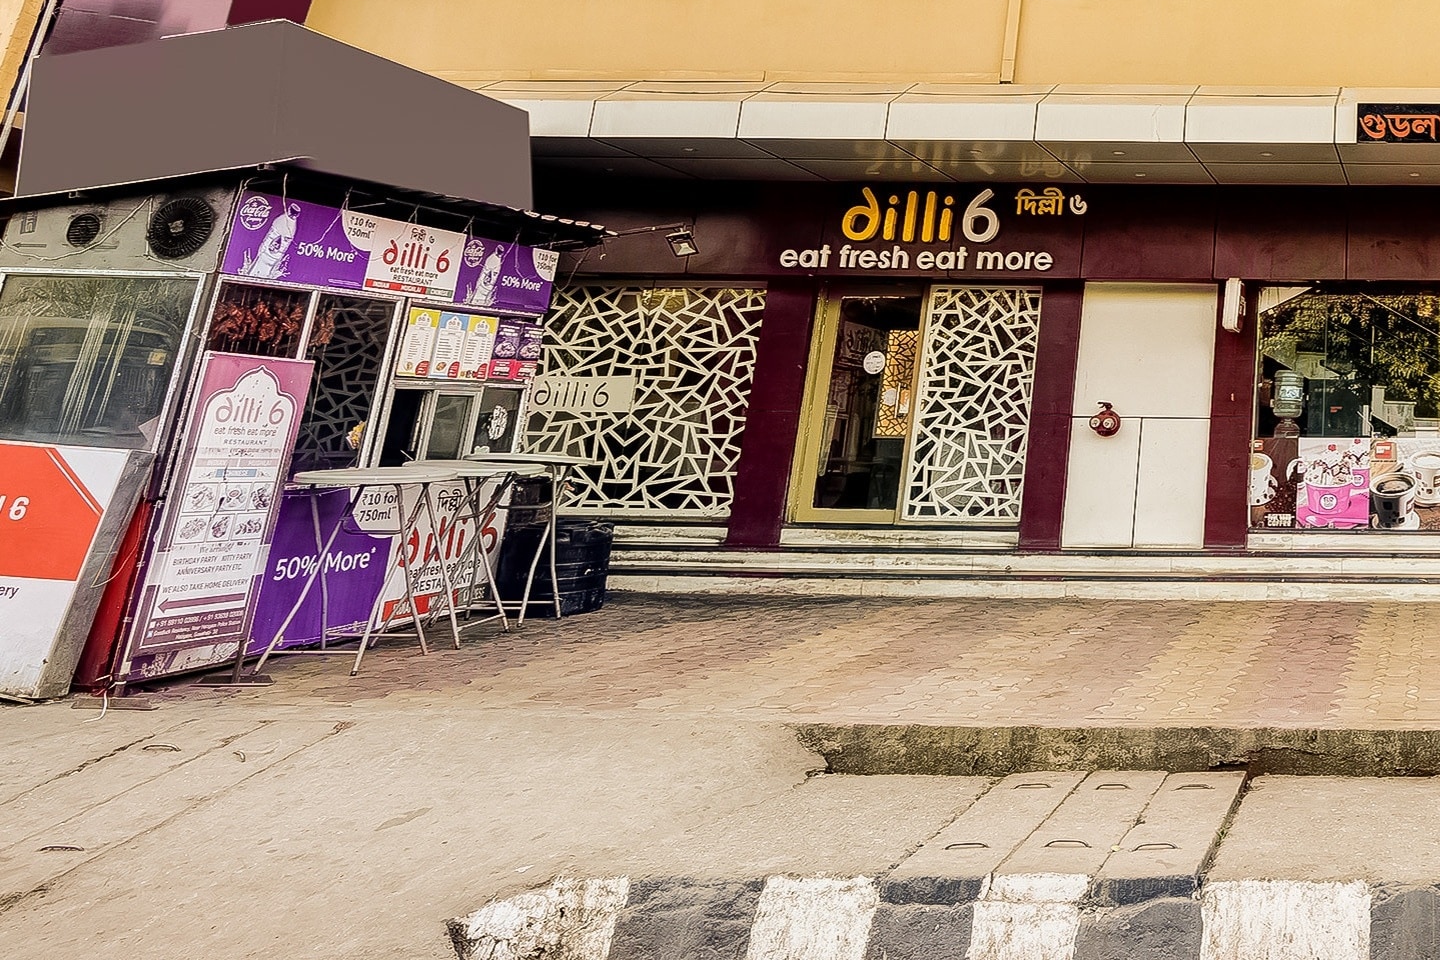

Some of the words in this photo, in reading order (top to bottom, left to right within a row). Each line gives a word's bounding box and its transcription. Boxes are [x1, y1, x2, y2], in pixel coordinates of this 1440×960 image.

[842, 187, 954, 242] dilli
[962, 188, 1000, 243] 6
[364, 219, 377, 229] for
[296, 241, 325, 258] 50%
[382, 239, 431, 270] dilli
[436, 249, 450, 273] 6
[779, 245, 832, 269] eat
[839, 245, 910, 270] fresh
[916, 246, 969, 271] eat
[976, 250, 1054, 271] more
[389, 266, 400, 274] eat
[400, 266, 415, 276] fresh
[415, 269, 425, 278] eat
[424, 271, 439, 280] more
[392, 274, 434, 286] RESTAURANT
[501, 275, 520, 289] 50%
[534, 380, 590, 408] dilli
[593, 382, 609, 407] 6
[269, 400, 285, 425] 6
[214, 427, 226, 435] eat
[228, 425, 246, 436] fresh
[247, 427, 259, 436] eat
[383, 492, 398, 505] for
[172, 556, 200, 566] BIRTHDAY
[200, 555, 218, 563] PARTY
[236, 552, 253, 560] PARTY
[176, 566, 215, 575] ANNIVERSARY
[214, 564, 231, 572] PARTY
[273, 554, 318, 581] 50%
[162, 586, 173, 594] WE
[172, 584, 189, 592] ALSO
[188, 582, 204, 591] TAKE
[204, 580, 222, 589] HOME
[221, 578, 250, 588] DELIVERY
